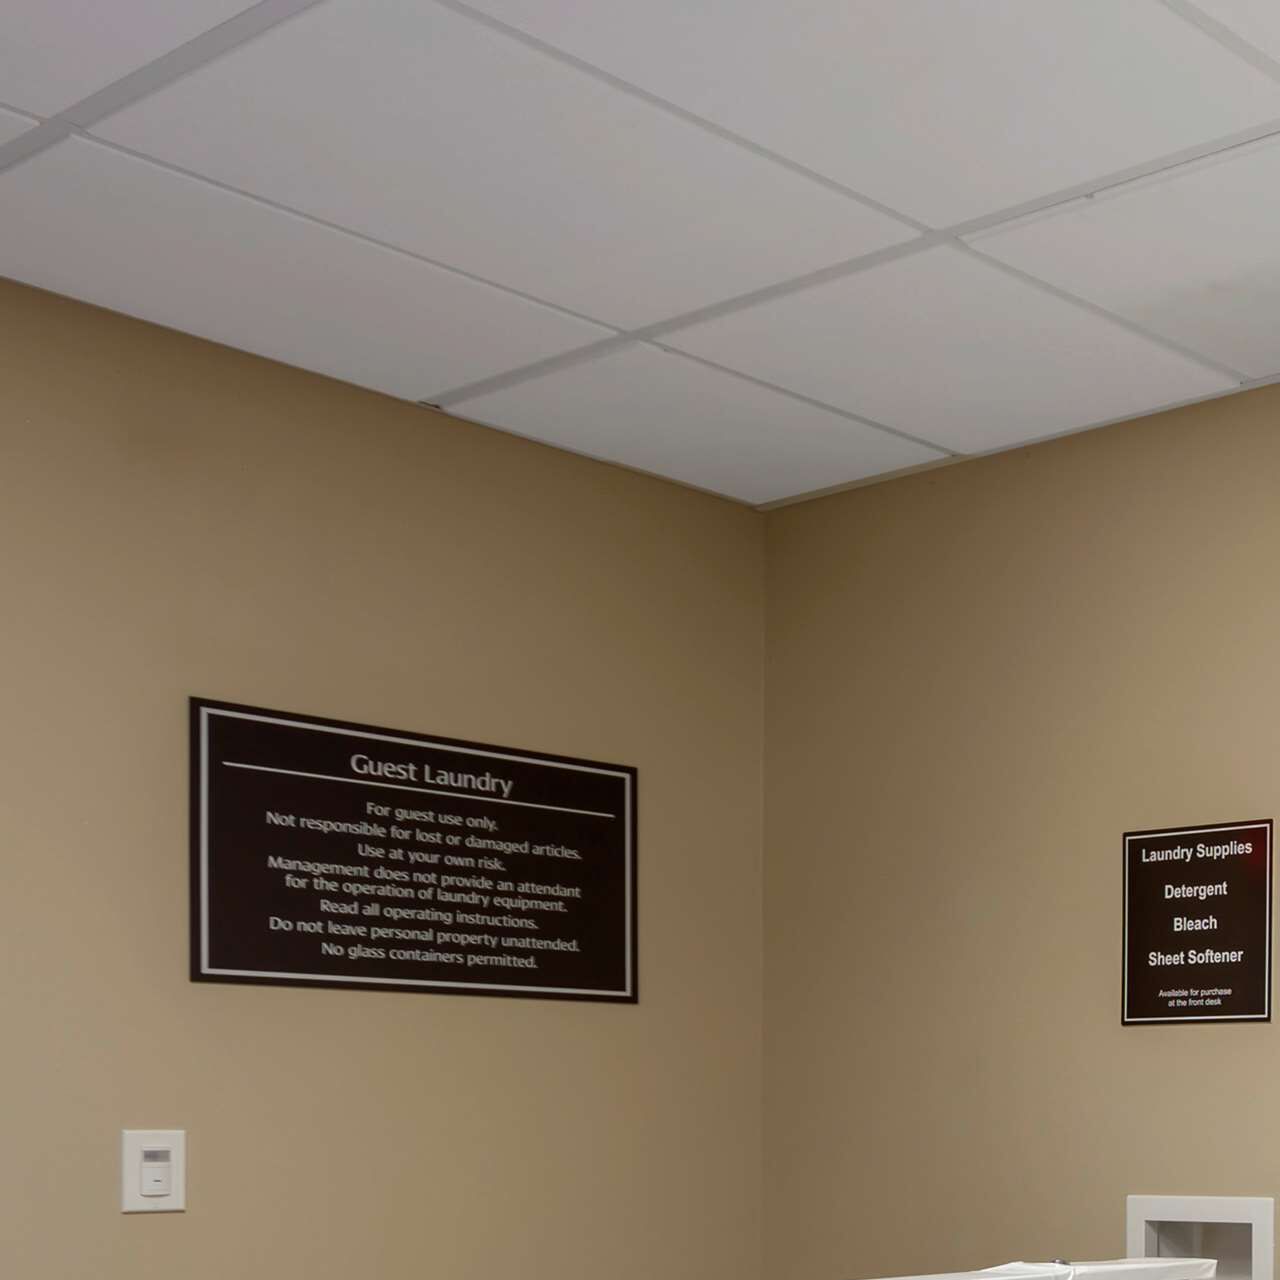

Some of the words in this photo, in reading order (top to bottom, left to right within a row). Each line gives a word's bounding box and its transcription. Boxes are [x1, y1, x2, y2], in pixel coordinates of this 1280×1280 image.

[350, 754, 418, 781] Guest
[424, 764, 513, 798] Laundry
[366, 802, 391, 816] For
[395, 807, 434, 823] guest
[438, 813, 463, 826] use
[466, 816, 498, 832] only.
[266, 811, 296, 827] Not
[299, 817, 387, 838] responsible
[390, 825, 413, 840] for
[415, 828, 442, 844] lost
[445, 834, 461, 845] or
[465, 835, 529, 854] damaged
[532, 844, 582, 860] articles.
[358, 843, 384, 857] Use
[388, 848, 404, 860] at
[408, 850, 441, 865] your
[444, 855, 475, 867] own
[478, 857, 507, 871] risk.
[1142, 846, 1193, 862] Laundry
[1196, 841, 1252, 860] Supplies
[267, 855, 370, 877] Management
[373, 866, 410, 881] does
[413, 871, 437, 884] not
[441, 875, 493, 889] provide
[497, 881, 514, 891] an
[517, 881, 581, 898] attendant
[1165, 881, 1228, 900] Detergent
[285, 874, 309, 889] for
[313, 877, 339, 891] the
[342, 882, 415, 899] operation
[417, 887, 434, 900] of
[437, 888, 490, 907] laundry
[493, 896, 568, 912] equipment.
[320, 899, 359, 915] Read
[362, 903, 380, 916] all
[383, 906, 454, 925] operating
[456, 910, 539, 929] instructions.
[1174, 915, 1217, 932] Bleach
[269, 916, 293, 931] Do
[296, 921, 324, 934] not
[328, 921, 368, 937] leave
[370, 926, 434, 943] personal
[437, 931, 498, 948] property
[501, 937, 580, 952] unattended.
[321, 942, 344, 956] No
[348, 944, 386, 960] glass
[389, 949, 464, 964] containers
[467, 954, 538, 968] permitted.
[1148, 951, 1184, 966] Sheet
[1188, 949, 1244, 965] Softener
[1159, 988, 1188, 997] Available
[1190, 988, 1199, 996] for
[1200, 988, 1232, 997] purchase
[1188, 998, 1204, 1006] front
[1205, 998, 1222, 1006] desk
